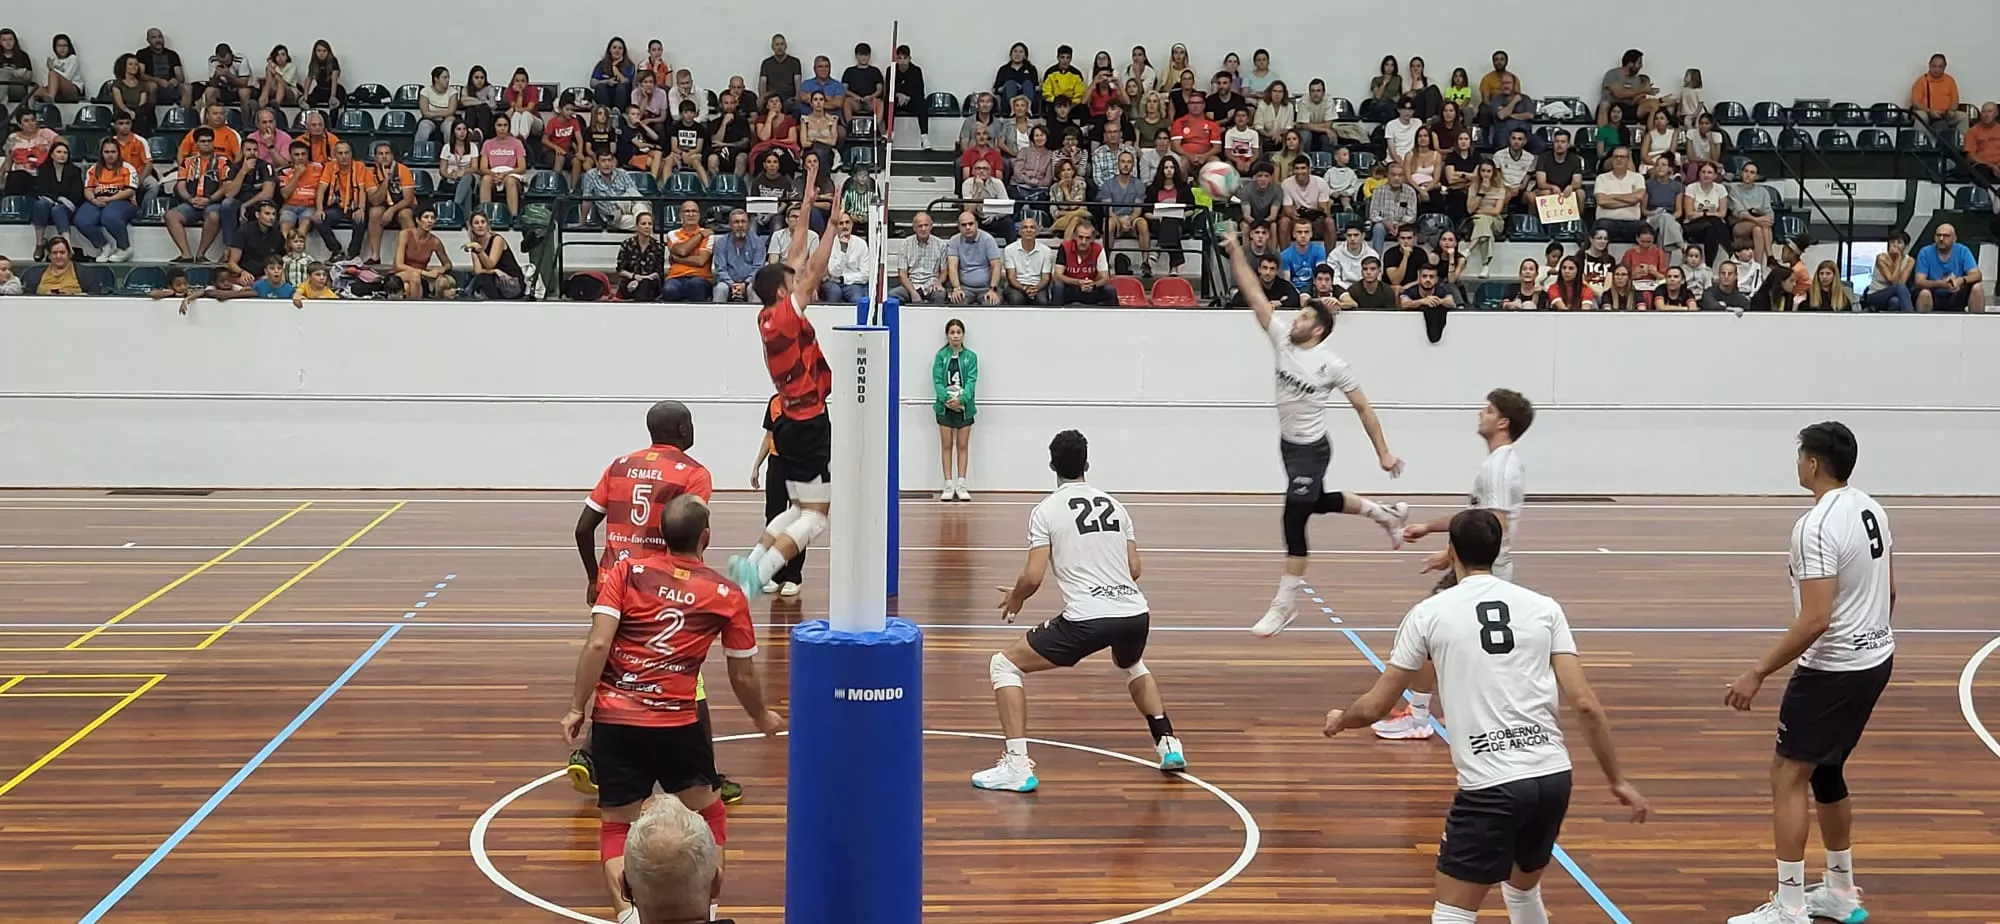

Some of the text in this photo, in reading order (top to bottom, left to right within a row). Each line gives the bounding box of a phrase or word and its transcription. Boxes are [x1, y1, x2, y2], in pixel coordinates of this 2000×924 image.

[857, 357, 867, 404] MONDO
[947, 371, 961, 386] 14
[626, 467, 664, 481] ISMAEL
[630, 483, 653, 526] 5
[1067, 496, 1121, 536] 22
[1860, 508, 1884, 560] 9
[658, 586, 696, 606] FALO
[645, 607, 685, 656] 2
[1475, 600, 1515, 655] 8
[847, 687, 904, 701] MONDO
[1490, 741, 1506, 752] DE
